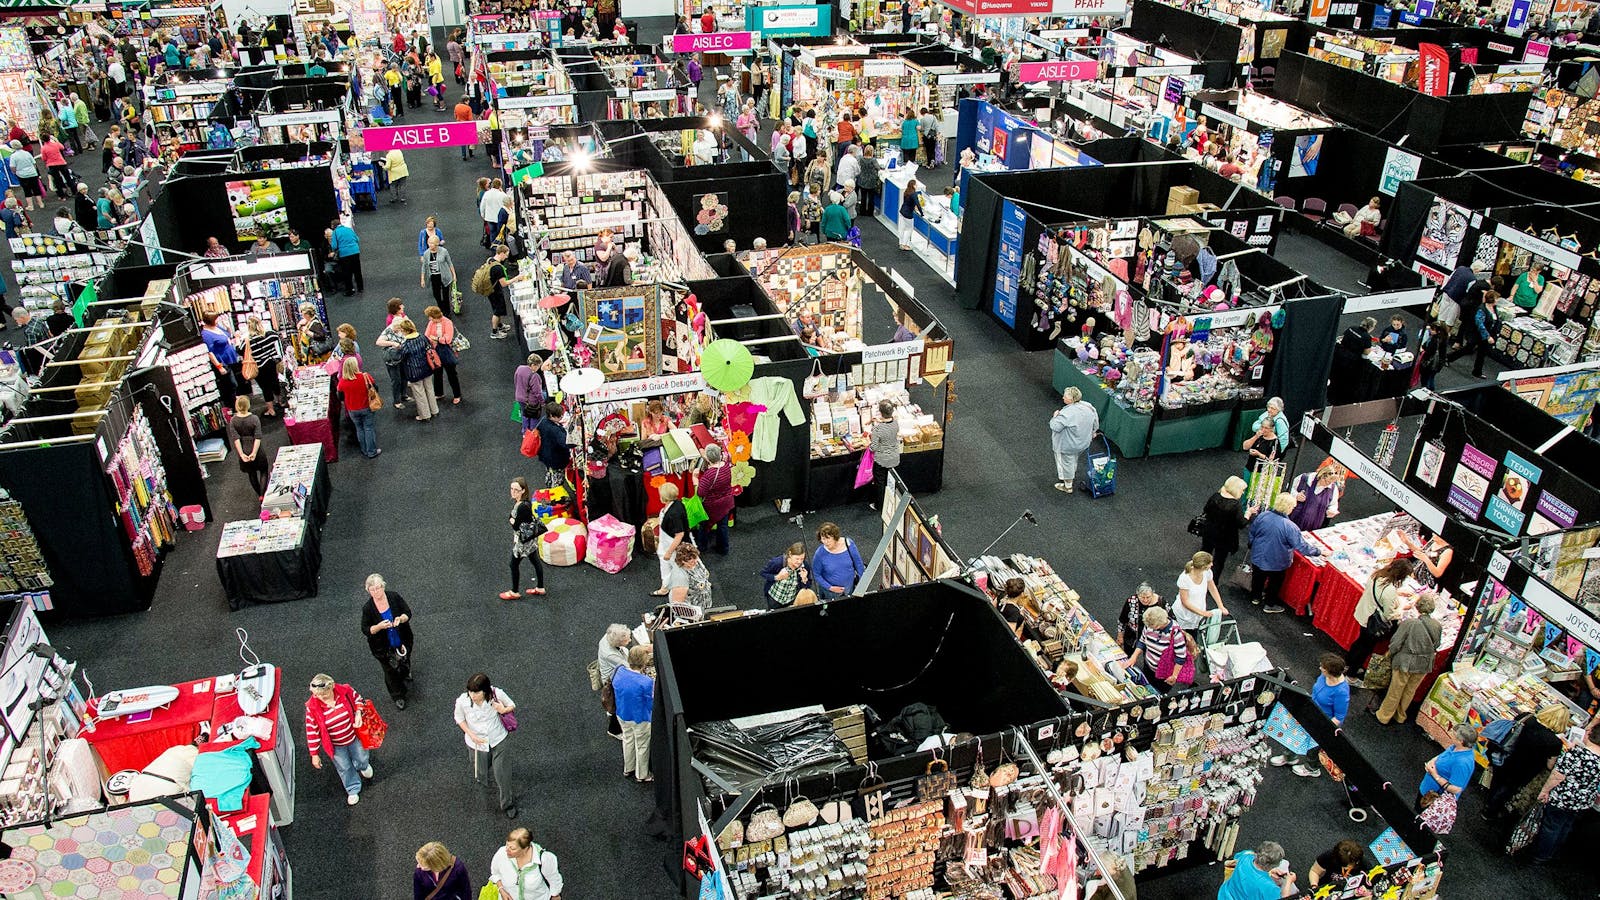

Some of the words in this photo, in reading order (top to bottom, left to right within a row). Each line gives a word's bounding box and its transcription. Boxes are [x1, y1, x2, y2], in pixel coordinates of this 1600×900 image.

[1075, 0, 1105, 9] PFAFF
[692, 36, 722, 49] AISLE
[723, 36, 733, 48] C
[1038, 65, 1067, 79] AISLE
[1069, 64, 1080, 78] D
[1424, 57, 1434, 96] ERNINA
[392, 128, 434, 146] AISLE
[439, 127, 450, 143] B
[1222, 315, 1240, 323] Lynette
[864, 348, 895, 358] Patchwork
[897, 346, 905, 356] By
[907, 345, 918, 354] Sea
[615, 385, 640, 395] Scarlet
[641, 383, 648, 392] &
[649, 382, 669, 391] Grace
[671, 379, 698, 389] Designs
[1461, 457, 1495, 480] SCISSORS
[1464, 449, 1497, 472] SCISSORS
[1509, 459, 1534, 479] TEDDY
[1358, 461, 1390, 490] TINKERING
[1389, 484, 1410, 505] TOOLS
[1448, 496, 1479, 520] TWEEZERS
[1451, 490, 1482, 514] TWEEZERS
[1492, 497, 1525, 522] TURNING
[1539, 499, 1574, 525] TWEEZERS
[1542, 491, 1577, 518] TWEEZERS
[1493, 508, 1515, 528] TOOLS
[1491, 558, 1507, 575] C08
[1566, 613, 1589, 633] JOYS
